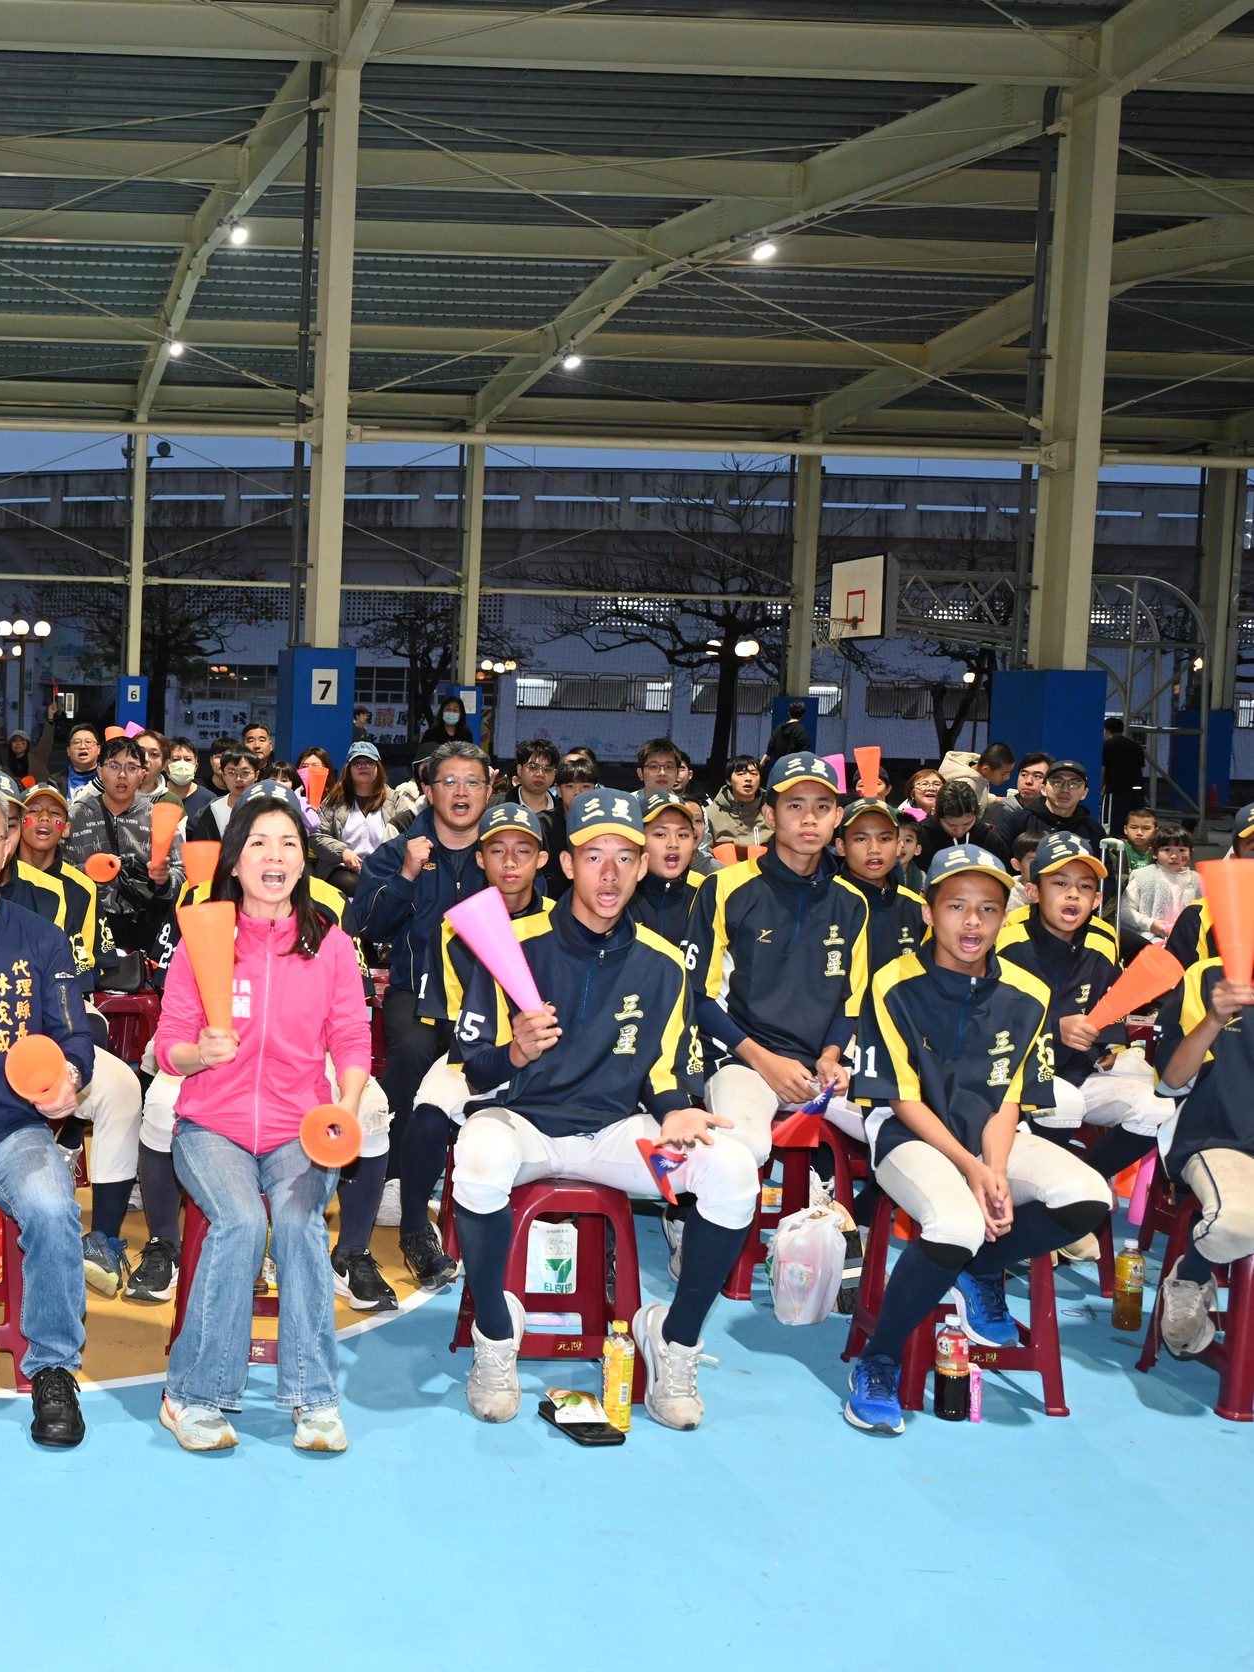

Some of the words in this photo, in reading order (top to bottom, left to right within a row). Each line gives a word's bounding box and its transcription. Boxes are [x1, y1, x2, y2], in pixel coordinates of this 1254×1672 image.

[130, 690, 138, 700] 6
[318, 680, 332, 700] 7
[784, 758, 829, 777] 三星
[247, 785, 289, 802] 三星
[489, 808, 531, 826] 三星
[581, 797, 633, 822] 三星
[823, 924, 846, 977] 三星
[232, 979, 251, 994] 員
[11, 958, 33, 1041] 代理縣長
[613, 994, 644, 1055] 三星
[987, 1030, 1015, 1087] 三星
